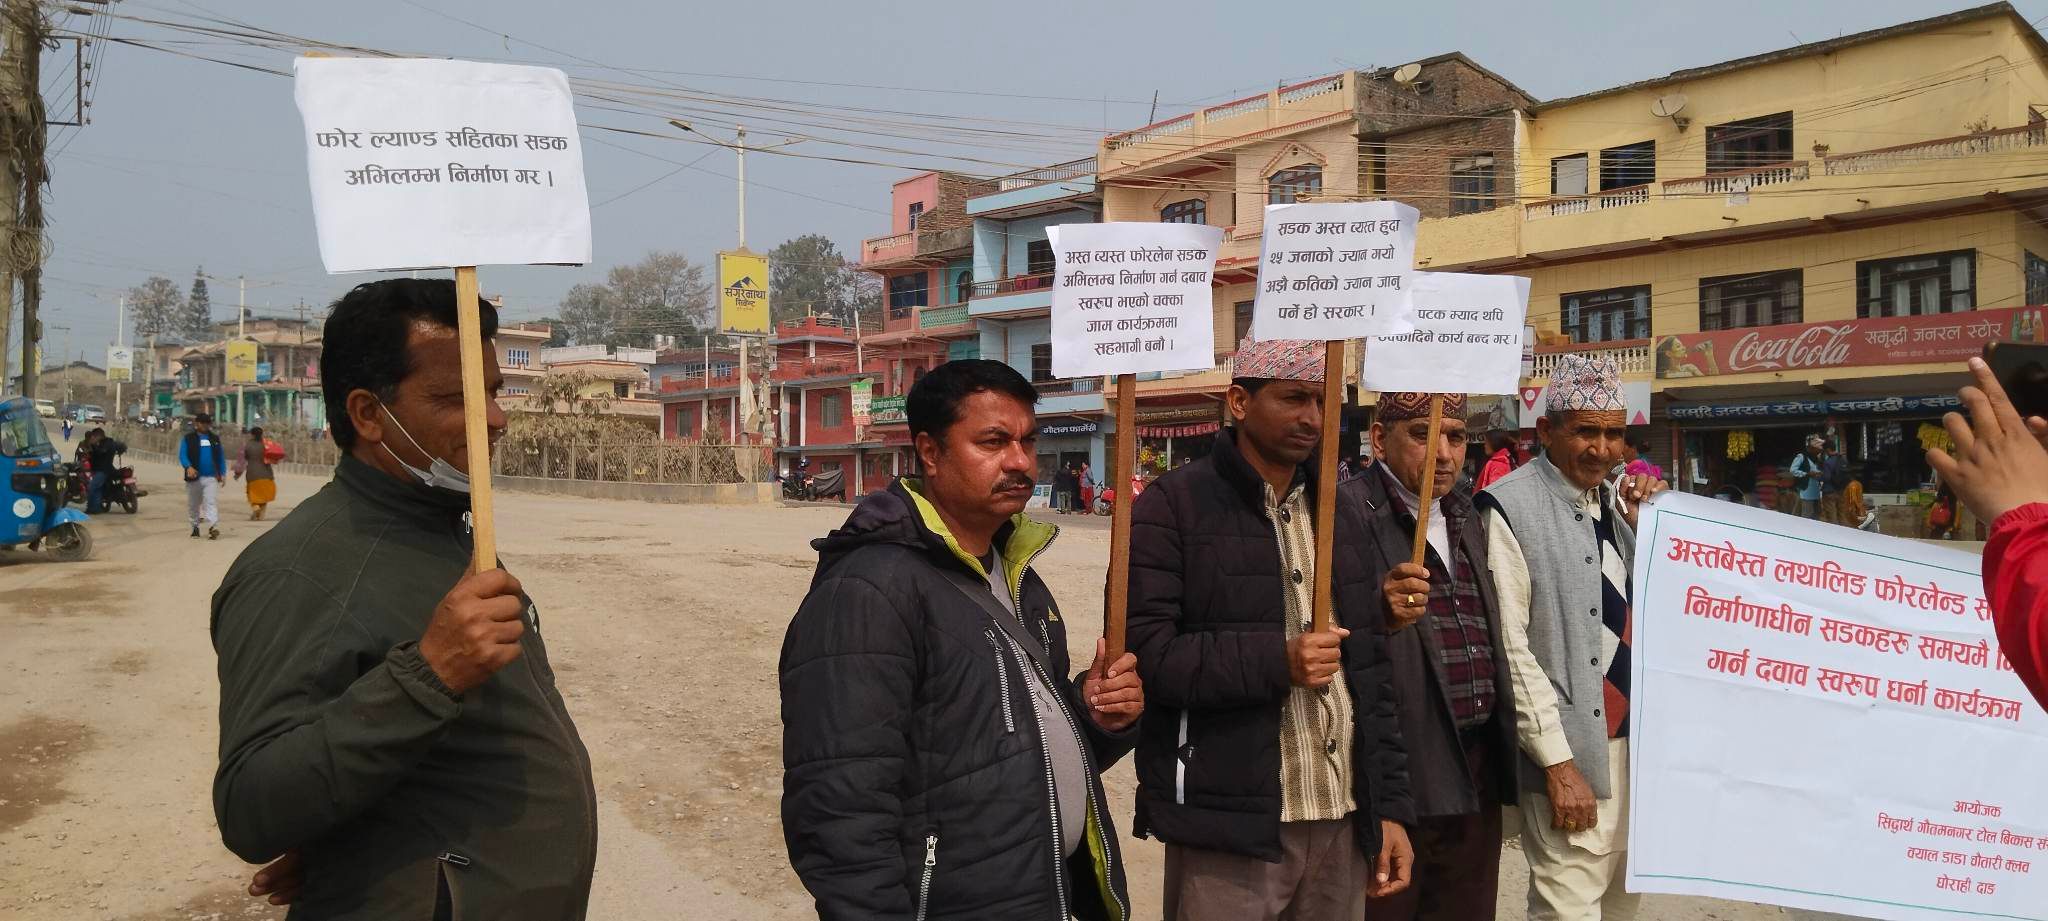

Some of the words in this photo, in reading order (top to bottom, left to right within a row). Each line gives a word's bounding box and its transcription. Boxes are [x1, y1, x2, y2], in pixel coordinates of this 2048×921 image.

[316, 128, 361, 149] फोर
[370, 131, 438, 148] ल्याण्ड
[446, 127, 518, 149] सहितका
[524, 133, 568, 151] सडक
[345, 164, 441, 186] अभिलम्भ
[448, 163, 509, 185] निर्माण
[515, 168, 541, 186] गर
[1278, 222, 1312, 236] सडक
[1315, 222, 1346, 236] अस्त
[1065, 250, 1091, 265] अस्त
[1095, 250, 1126, 264] व्यस्त
[1130, 246, 1174, 262] फोरलेन
[1177, 249, 1208, 262] सडक
[1288, 246, 1335, 263] जनाको
[1339, 248, 1368, 263] ज्यान
[1371, 244, 1395, 260] गयो
[1063, 271, 1115, 287] अभिलम्ब
[1119, 270, 1156, 286] निर्माण
[1159, 269, 1178, 284] गर्न
[1266, 275, 1289, 293] अझै
[1292, 275, 1338, 291] कतिको
[1343, 276, 1373, 291] ज्यान
[1377, 275, 1402, 291] जानु
[1117, 292, 1149, 308] भएको
[1153, 294, 1184, 307] चक्का
[1278, 303, 1300, 319] पर्ने
[1303, 303, 1319, 320] हो
[1323, 304, 1366, 320] सरकार
[1418, 309, 1447, 321] पटक
[1450, 309, 1480, 321] म्याद
[1482, 307, 1504, 321] थपि
[1086, 319, 1113, 333] जाम
[1116, 315, 1178, 332] कार्यक्रममा
[1913, 325, 1962, 342] जनरल
[1967, 319, 2003, 338] स्टोर
[1094, 338, 1141, 355] सहभागी
[1144, 336, 1165, 351] बनौ
[1437, 331, 1464, 344] कार्य
[1467, 333, 1490, 345] बन्द
[1493, 334, 1511, 345] गर
[1667, 536, 1768, 577] अस्तबेस्त
[1874, 574, 1967, 616] फोरलेन्ड
[1684, 585, 1812, 637] निर्माणाधीन
[1917, 635, 1990, 669] समयमै
[1707, 648, 1750, 677] गर्न
[1933, 688, 2023, 722] कार्यक्रम
[1953, 800, 2002, 818] आयोजक
[1917, 818, 1974, 841] गौतमनगर
[1976, 827, 1997, 844] टोल
[1936, 873, 1972, 893] घोराही
